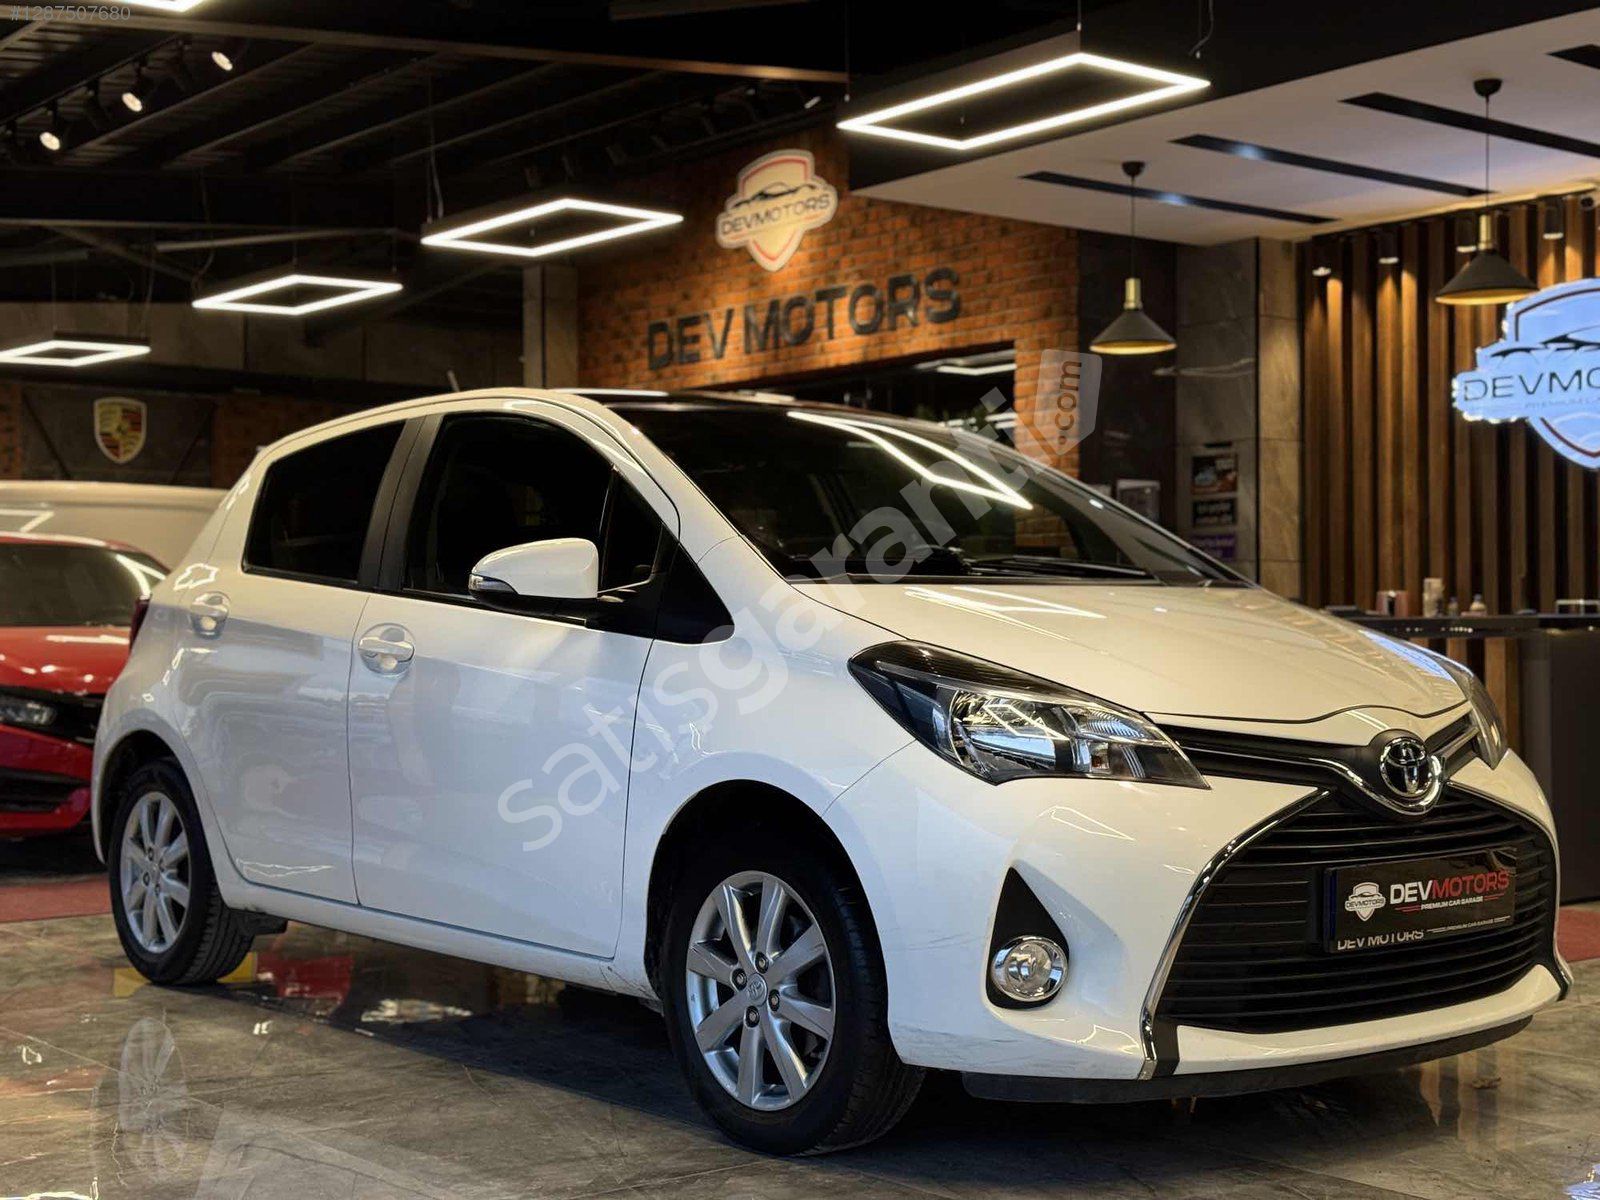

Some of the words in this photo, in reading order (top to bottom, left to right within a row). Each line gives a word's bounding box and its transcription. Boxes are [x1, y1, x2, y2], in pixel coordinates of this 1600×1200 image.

[721, 193, 830, 235] DEVMOTORS
[646, 307, 735, 371] DEV
[743, 267, 962, 355] MOTORS
[1390, 869, 1510, 905] DEVMOTORS
[1448, 898, 1461, 907] CAR
